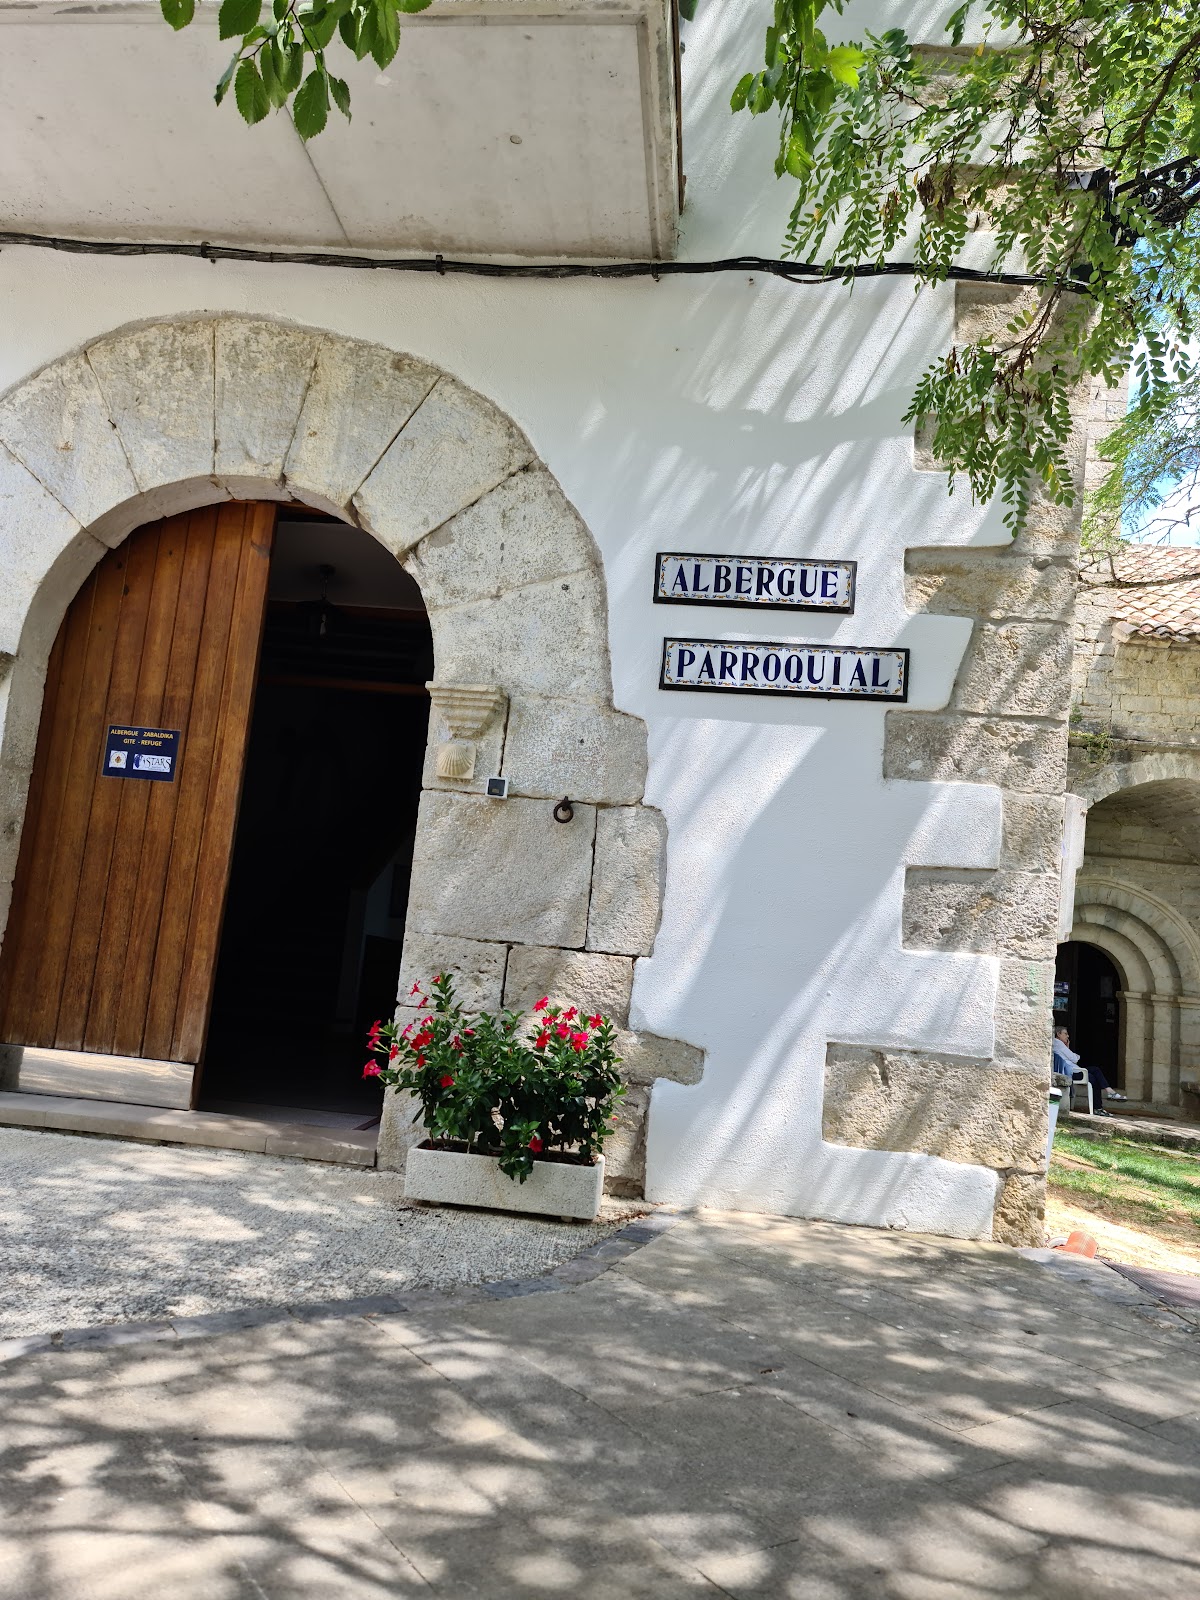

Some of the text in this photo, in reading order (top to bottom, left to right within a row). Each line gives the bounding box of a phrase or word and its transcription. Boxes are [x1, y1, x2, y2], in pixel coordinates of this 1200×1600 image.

[672, 563, 839, 599] ALBERGUE
[677, 648, 890, 688] PARROQUIAL
[110, 729, 174, 739] ALBERGUE ZABALDIKA
[141, 739, 162, 747] REFUGE
